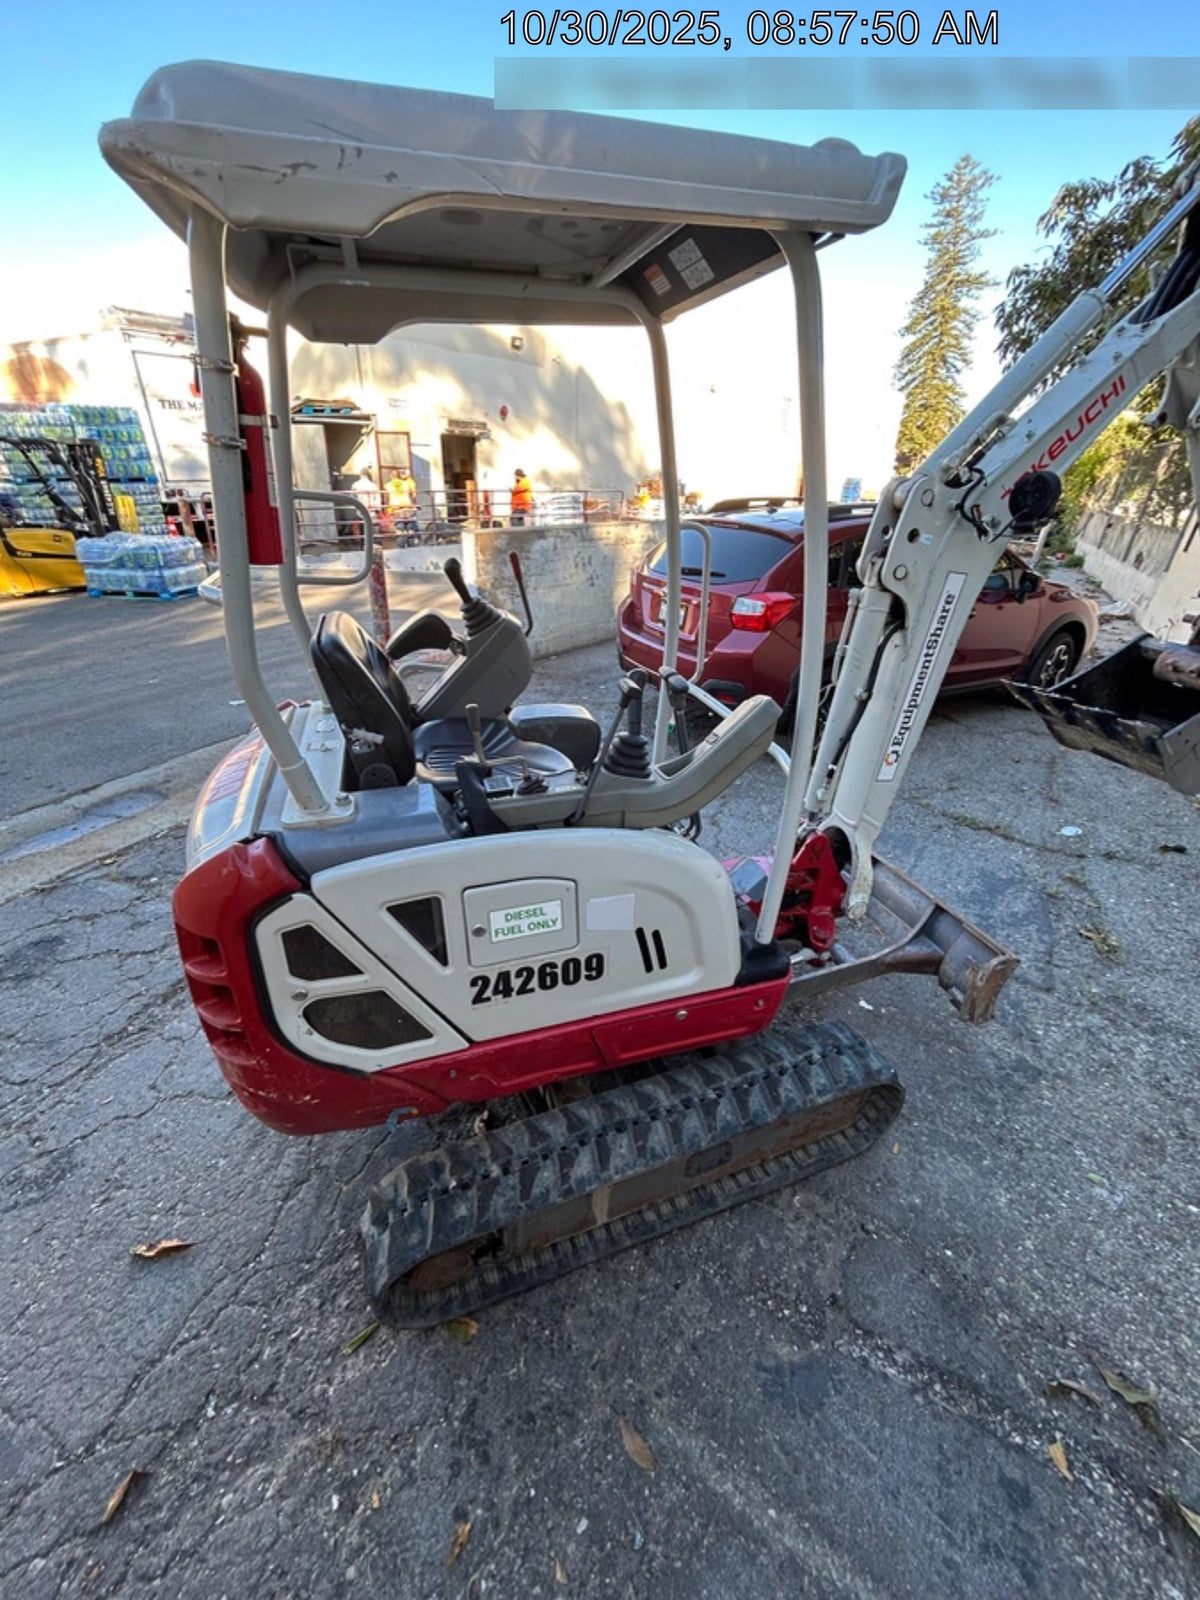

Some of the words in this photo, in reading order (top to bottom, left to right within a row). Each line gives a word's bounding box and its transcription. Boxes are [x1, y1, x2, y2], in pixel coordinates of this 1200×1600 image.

[158, 398, 185, 411] THE
[1001, 375, 1126, 499] KEUCHI
[892, 593, 956, 747] EquipmentShare
[494, 925, 524, 938] FUEL
[527, 917, 559, 932] ONLY
[504, 907, 547, 923] DIESEL
[469, 952, 605, 1005] 242609
